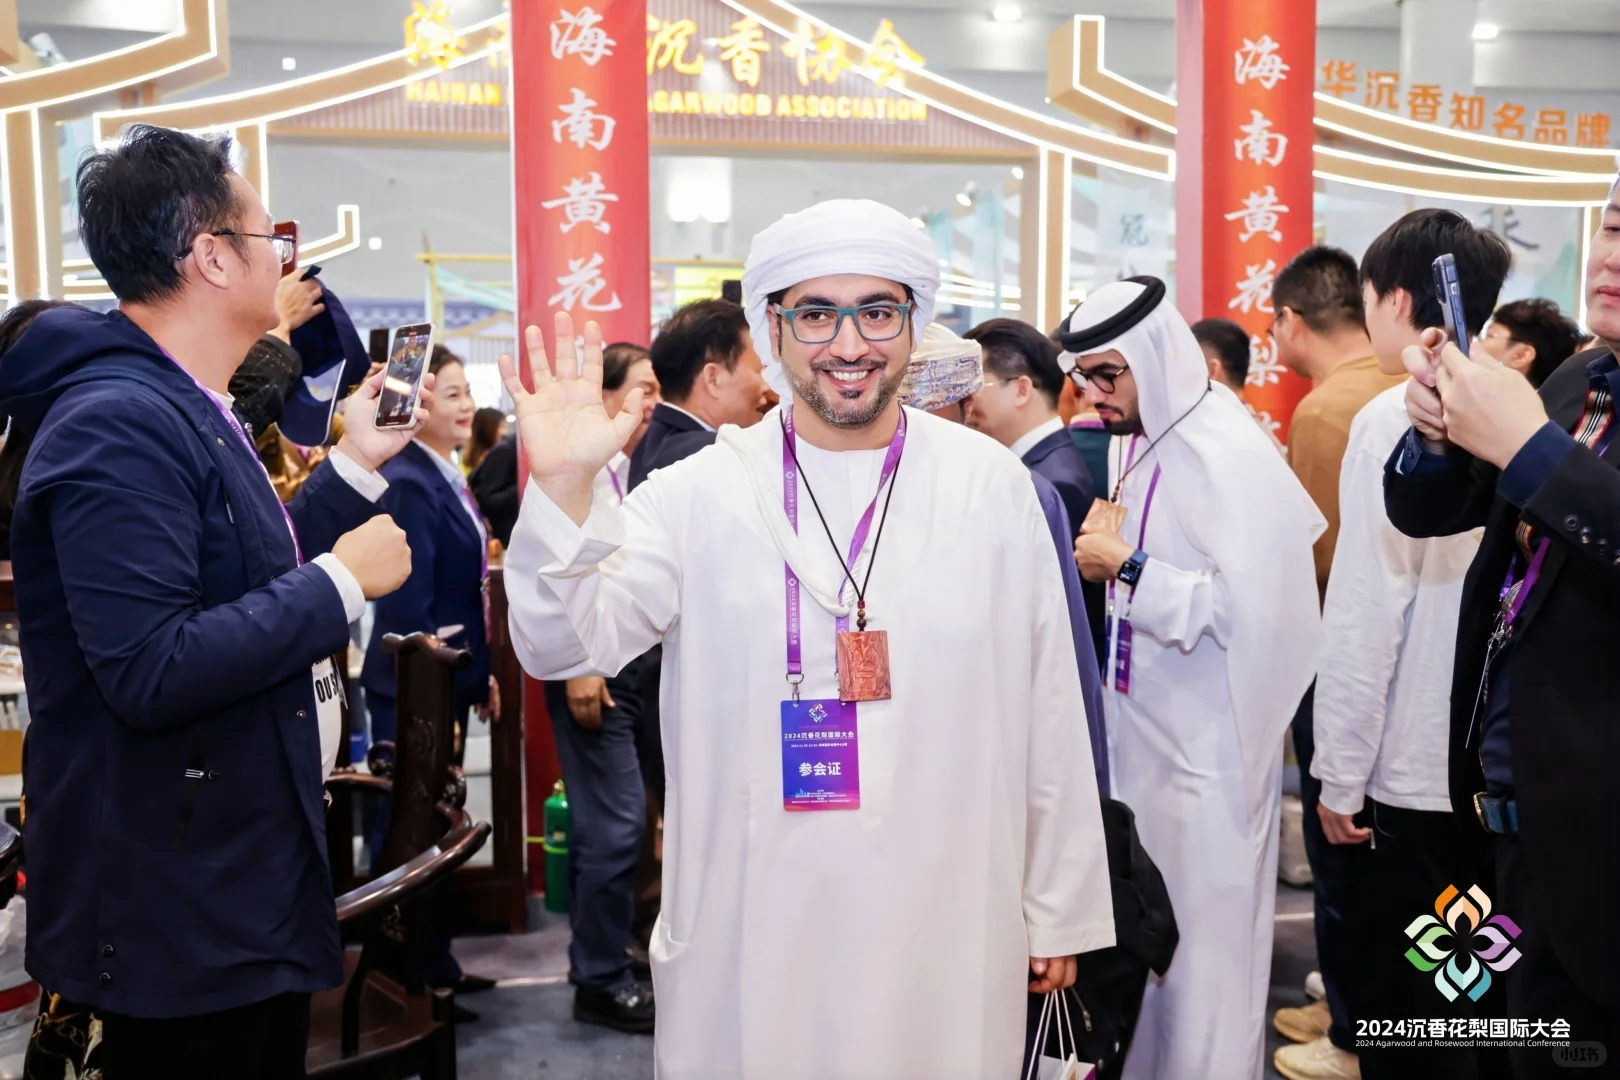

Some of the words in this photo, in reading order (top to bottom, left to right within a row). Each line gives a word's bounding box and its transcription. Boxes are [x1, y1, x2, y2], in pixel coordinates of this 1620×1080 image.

[776, 94, 928, 121] ASSOCIATION
[1320, 59, 1611, 146] 华沉香知名品牌
[541, 6, 622, 382] 海南黄花
[799, 761, 841, 777] 参会证
